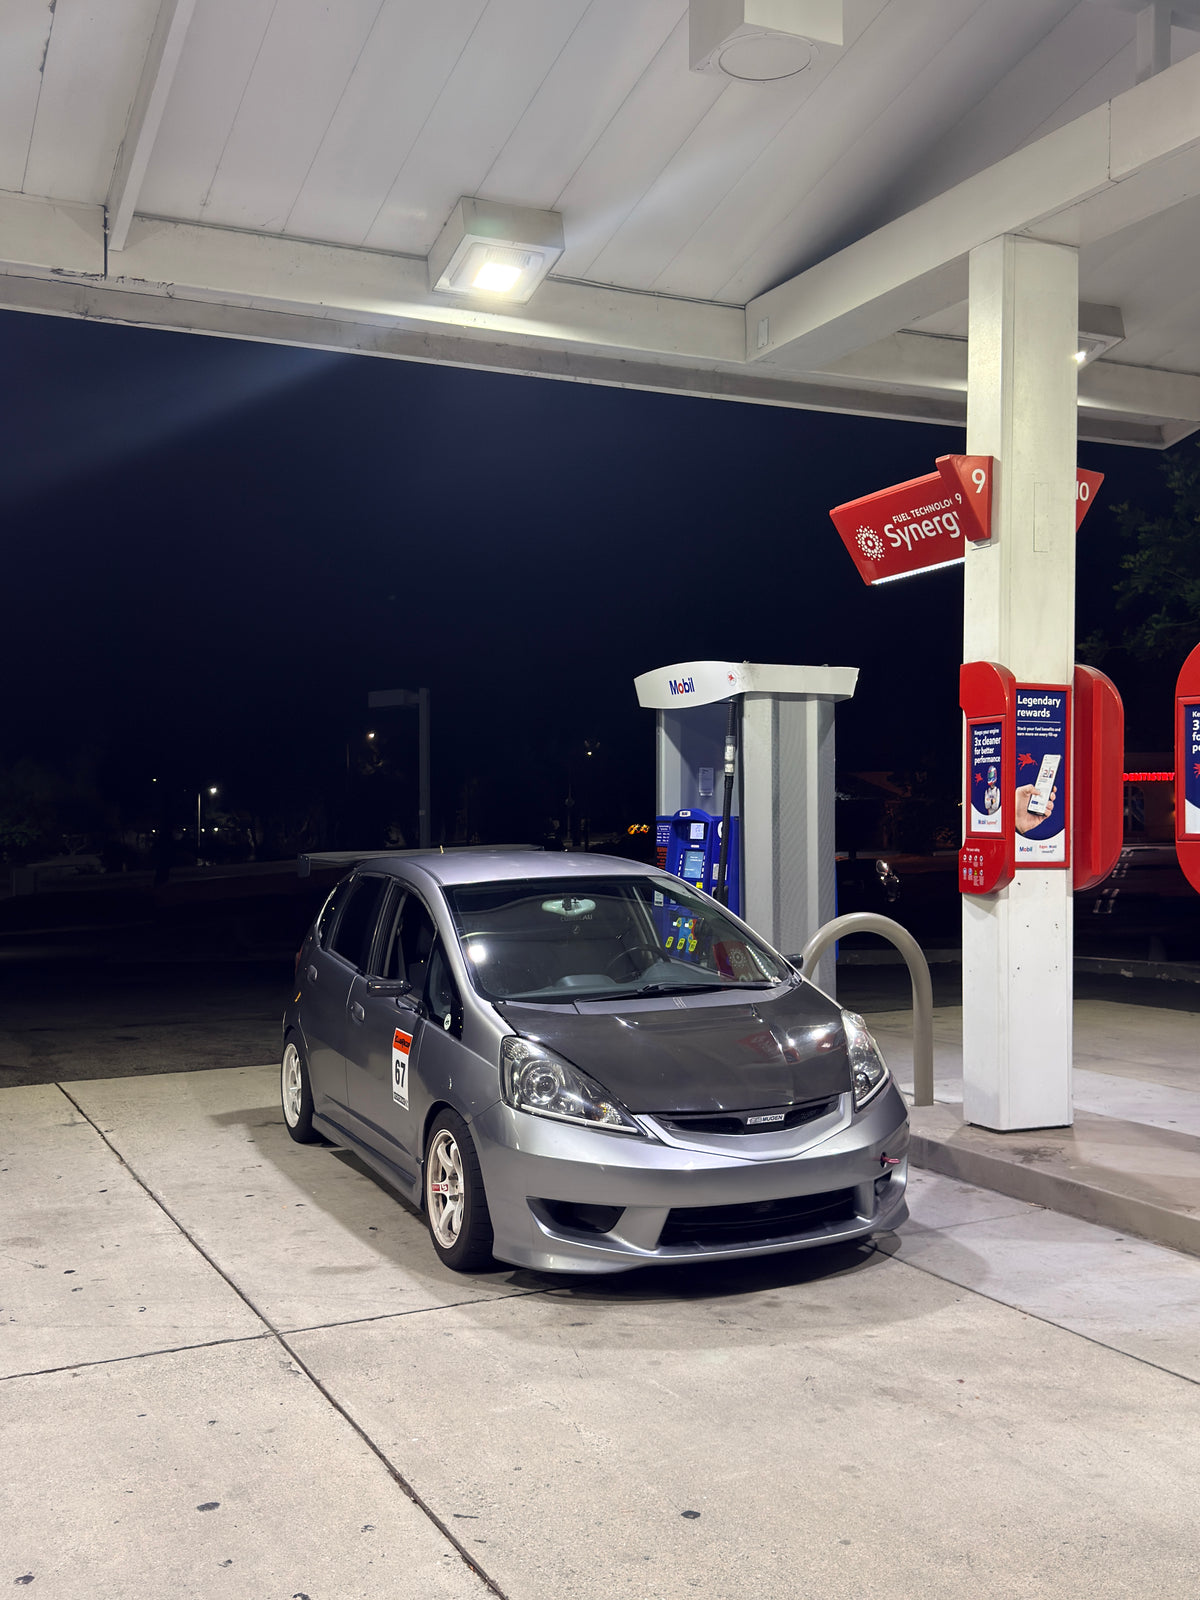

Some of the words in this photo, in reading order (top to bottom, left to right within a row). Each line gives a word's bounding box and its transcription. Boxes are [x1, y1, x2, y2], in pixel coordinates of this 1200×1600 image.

[972, 468, 986, 493] 9
[954, 492, 962, 505] 9
[892, 512, 911, 524] FUEL
[669, 677, 695, 695] Mobil
[1017, 695, 1061, 708] Legendary
[1017, 708, 1050, 718] rewards
[974, 737, 981, 746] 3x
[982, 736, 1001, 746] cleaner
[981, 746, 994, 755] better
[974, 756, 1000, 766] performance
[1122, 772, 1175, 781] DENTISTRY
[395, 1059, 406, 1088] 67
